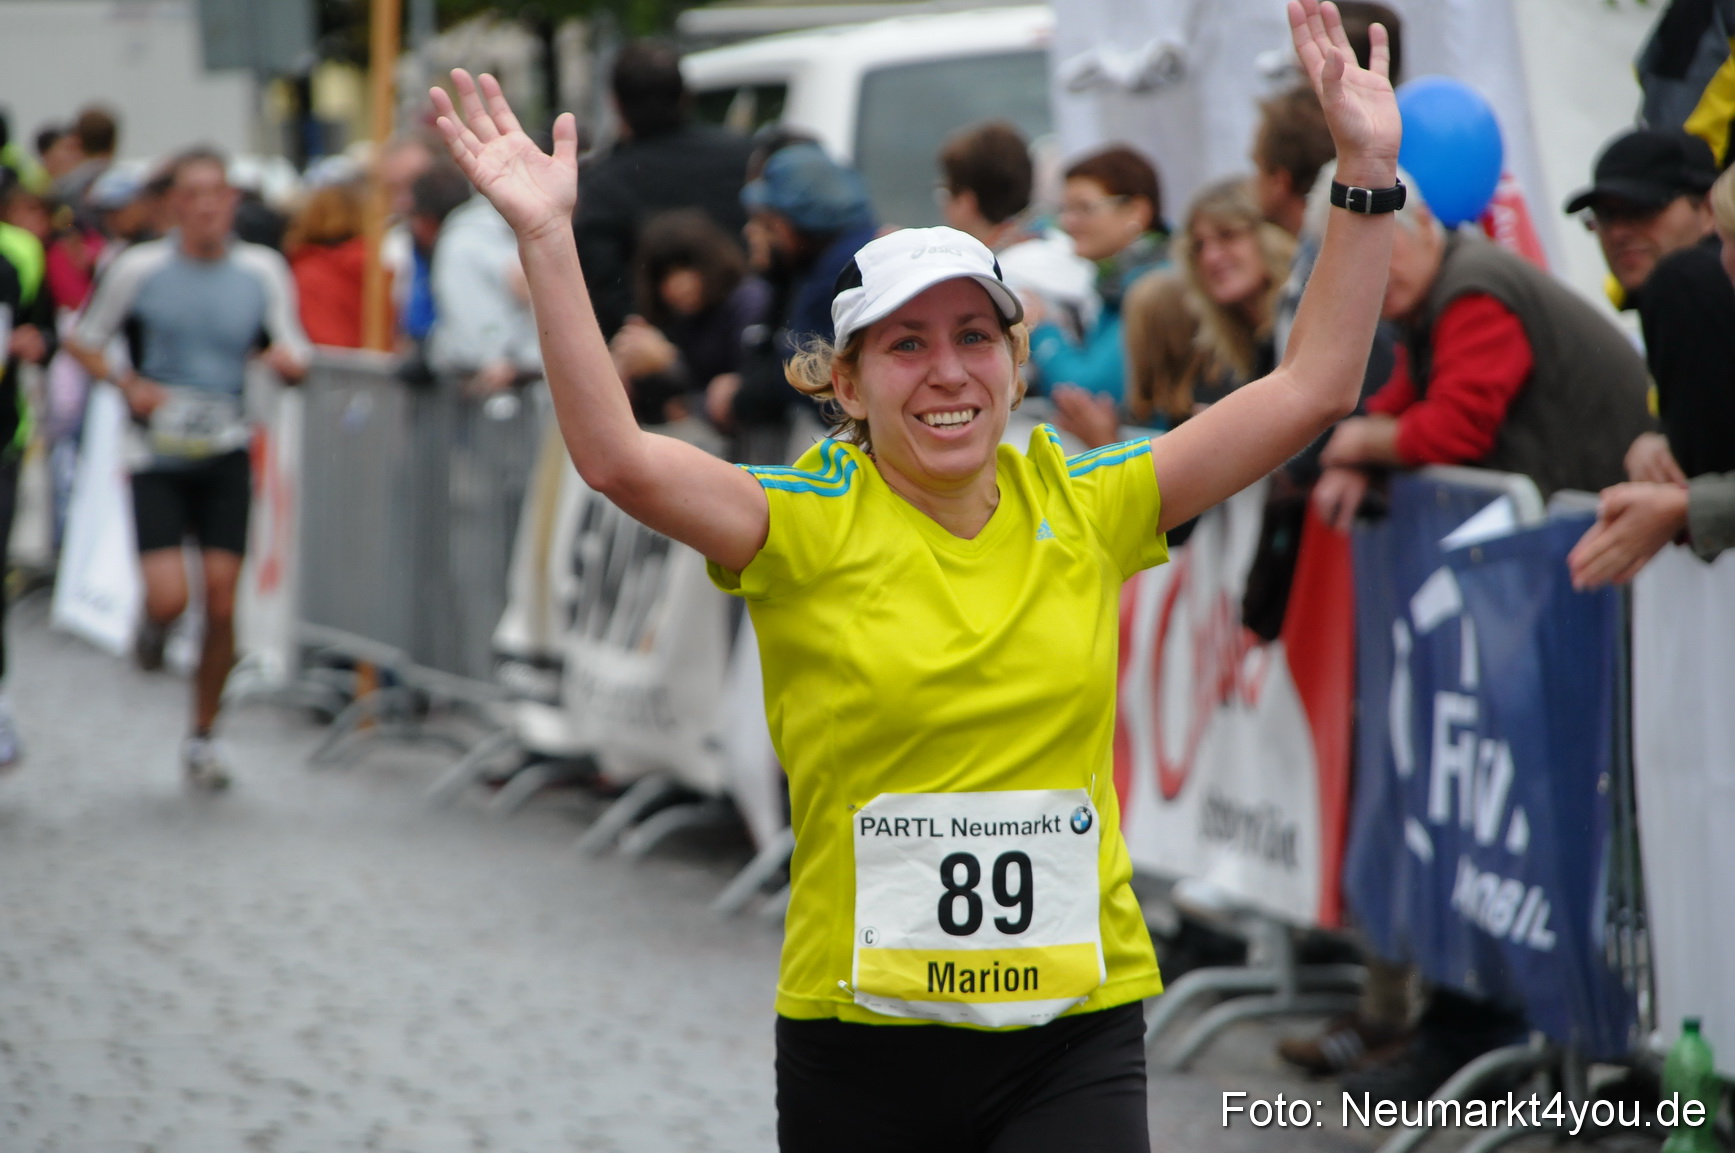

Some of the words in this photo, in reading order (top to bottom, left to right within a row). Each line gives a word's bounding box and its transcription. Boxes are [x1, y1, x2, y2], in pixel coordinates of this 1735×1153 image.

[860, 816, 944, 837] PARTL
[951, 814, 1061, 838] Neumarkt
[937, 850, 1034, 936] 89
[927, 961, 1039, 993] Marion
